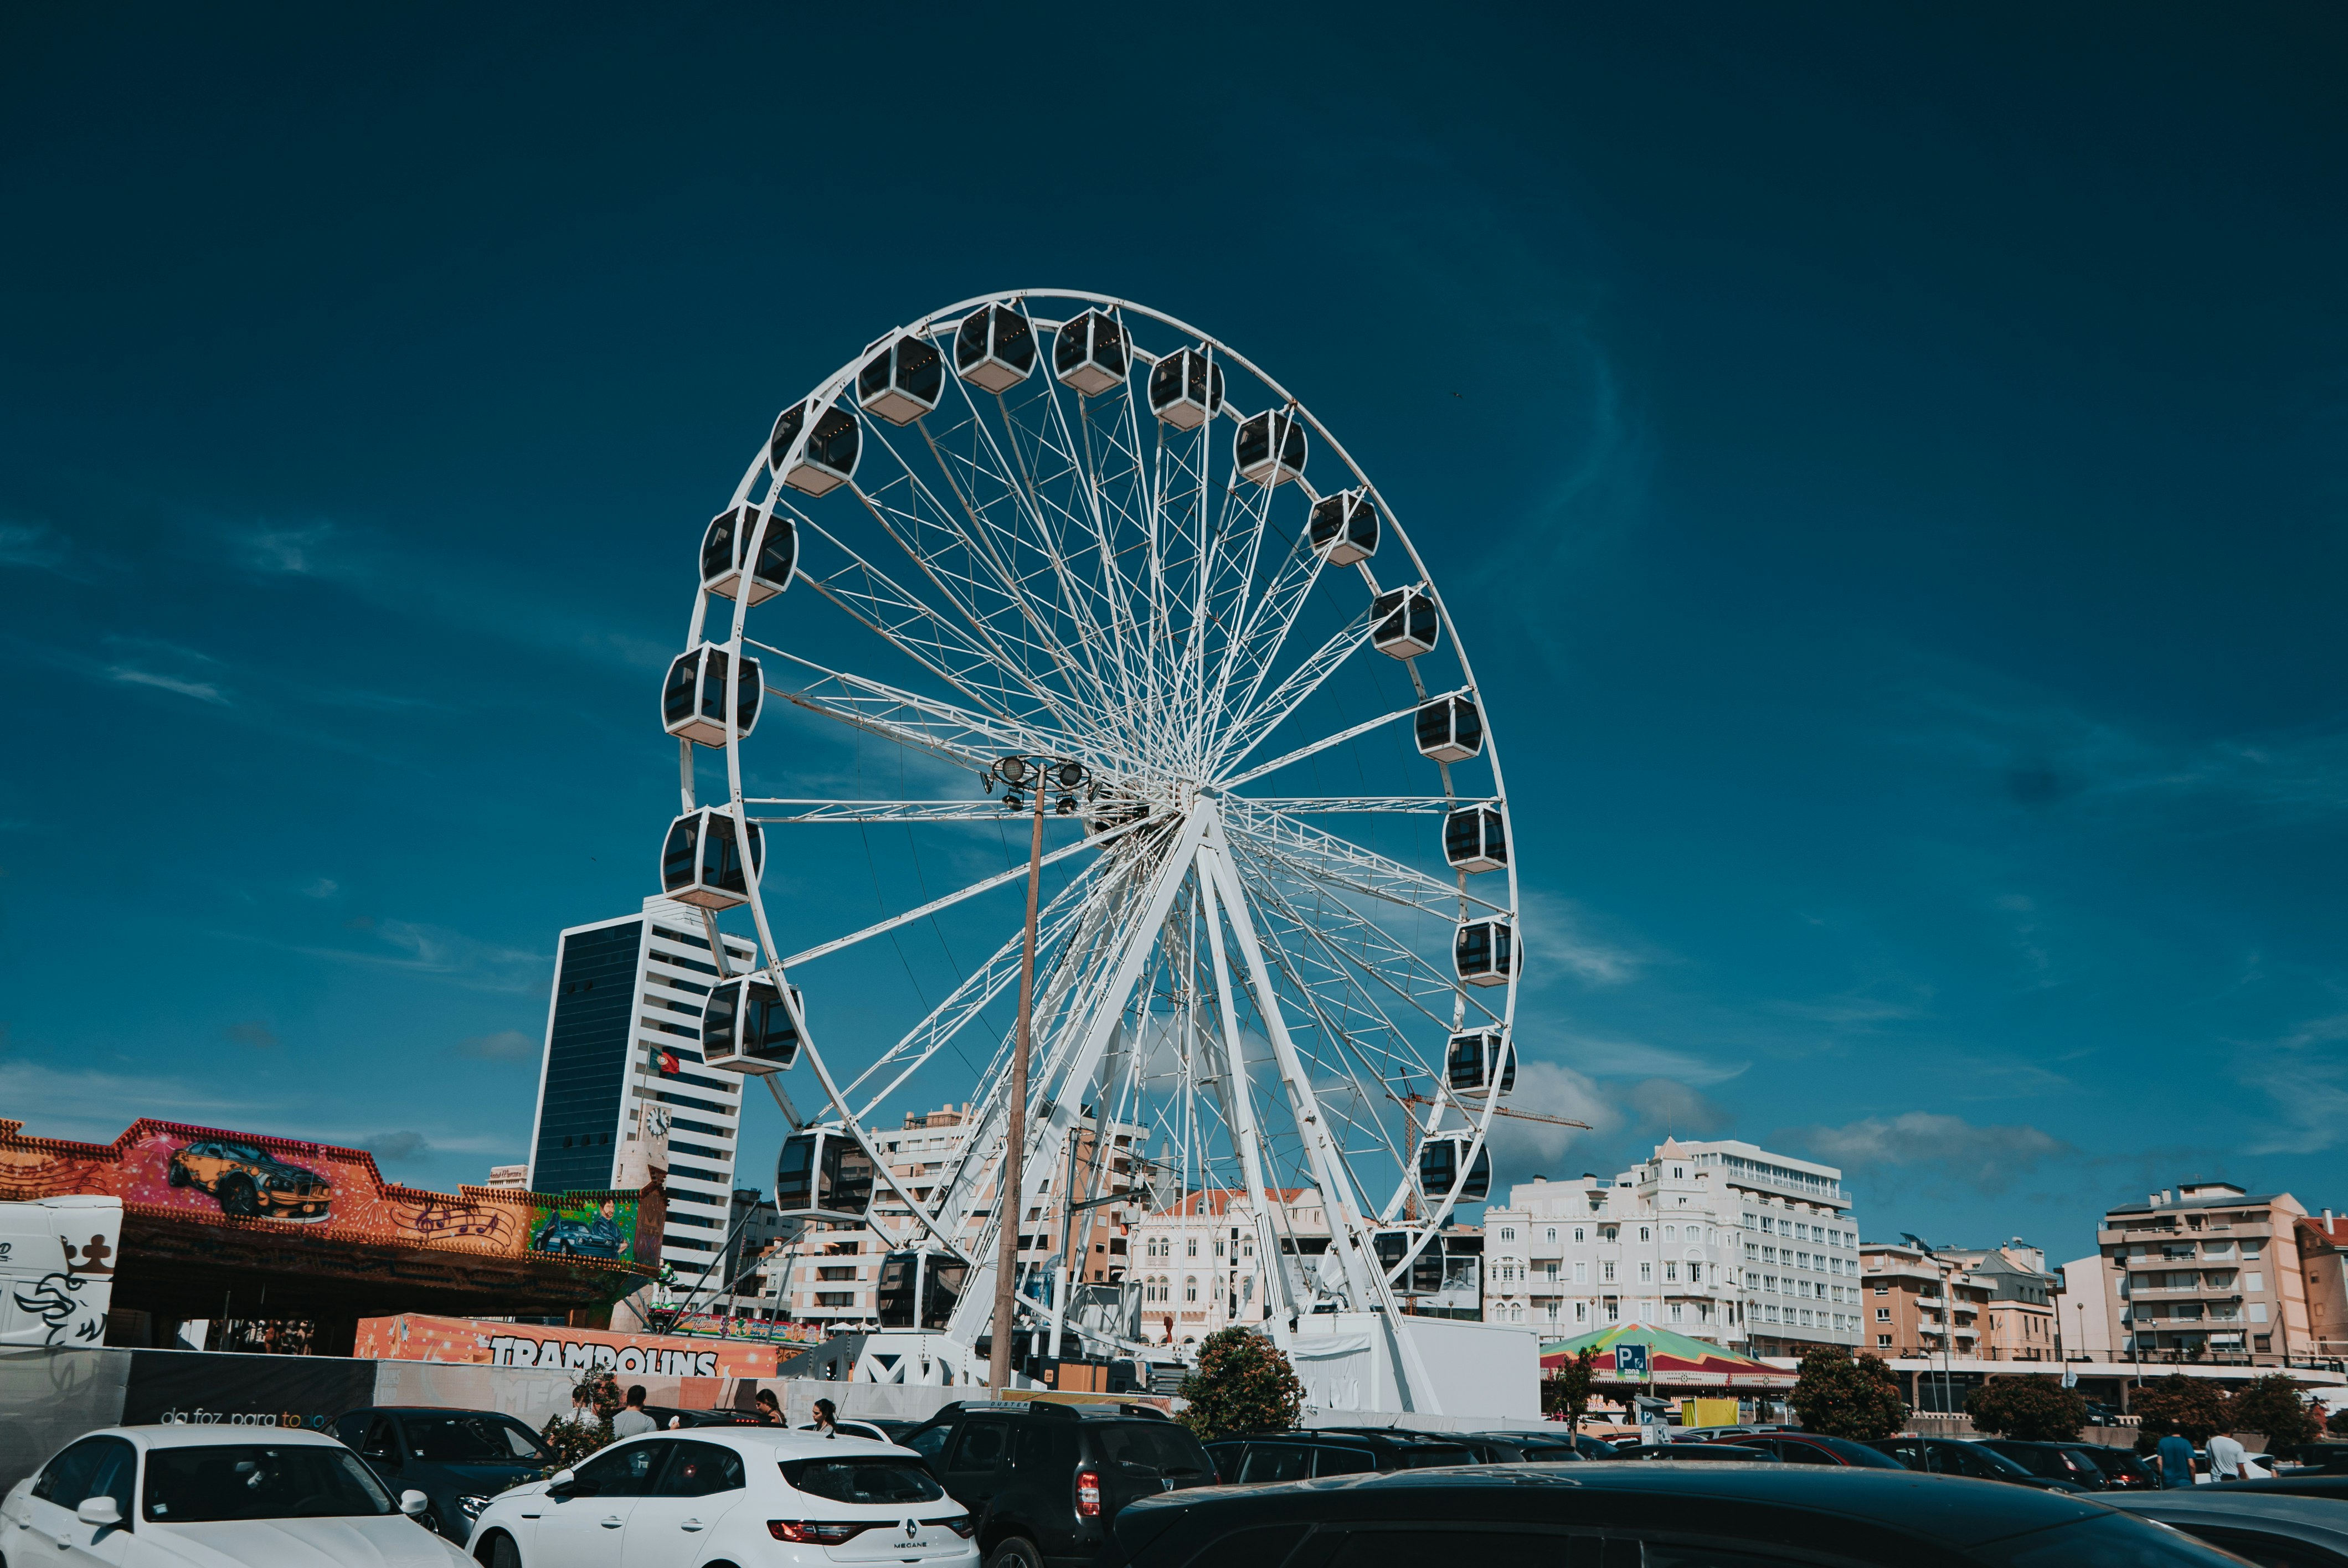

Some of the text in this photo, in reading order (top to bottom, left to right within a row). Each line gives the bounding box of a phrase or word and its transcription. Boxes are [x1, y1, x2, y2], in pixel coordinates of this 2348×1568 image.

[490, 1336, 719, 1378] TRAMPOLINS
[1619, 1348, 1632, 1368] P
[162, 1407, 188, 1425] da
[193, 1408, 223, 1425] foz
[230, 1412, 277, 1427] para
[1644, 1411, 1651, 1423] P
